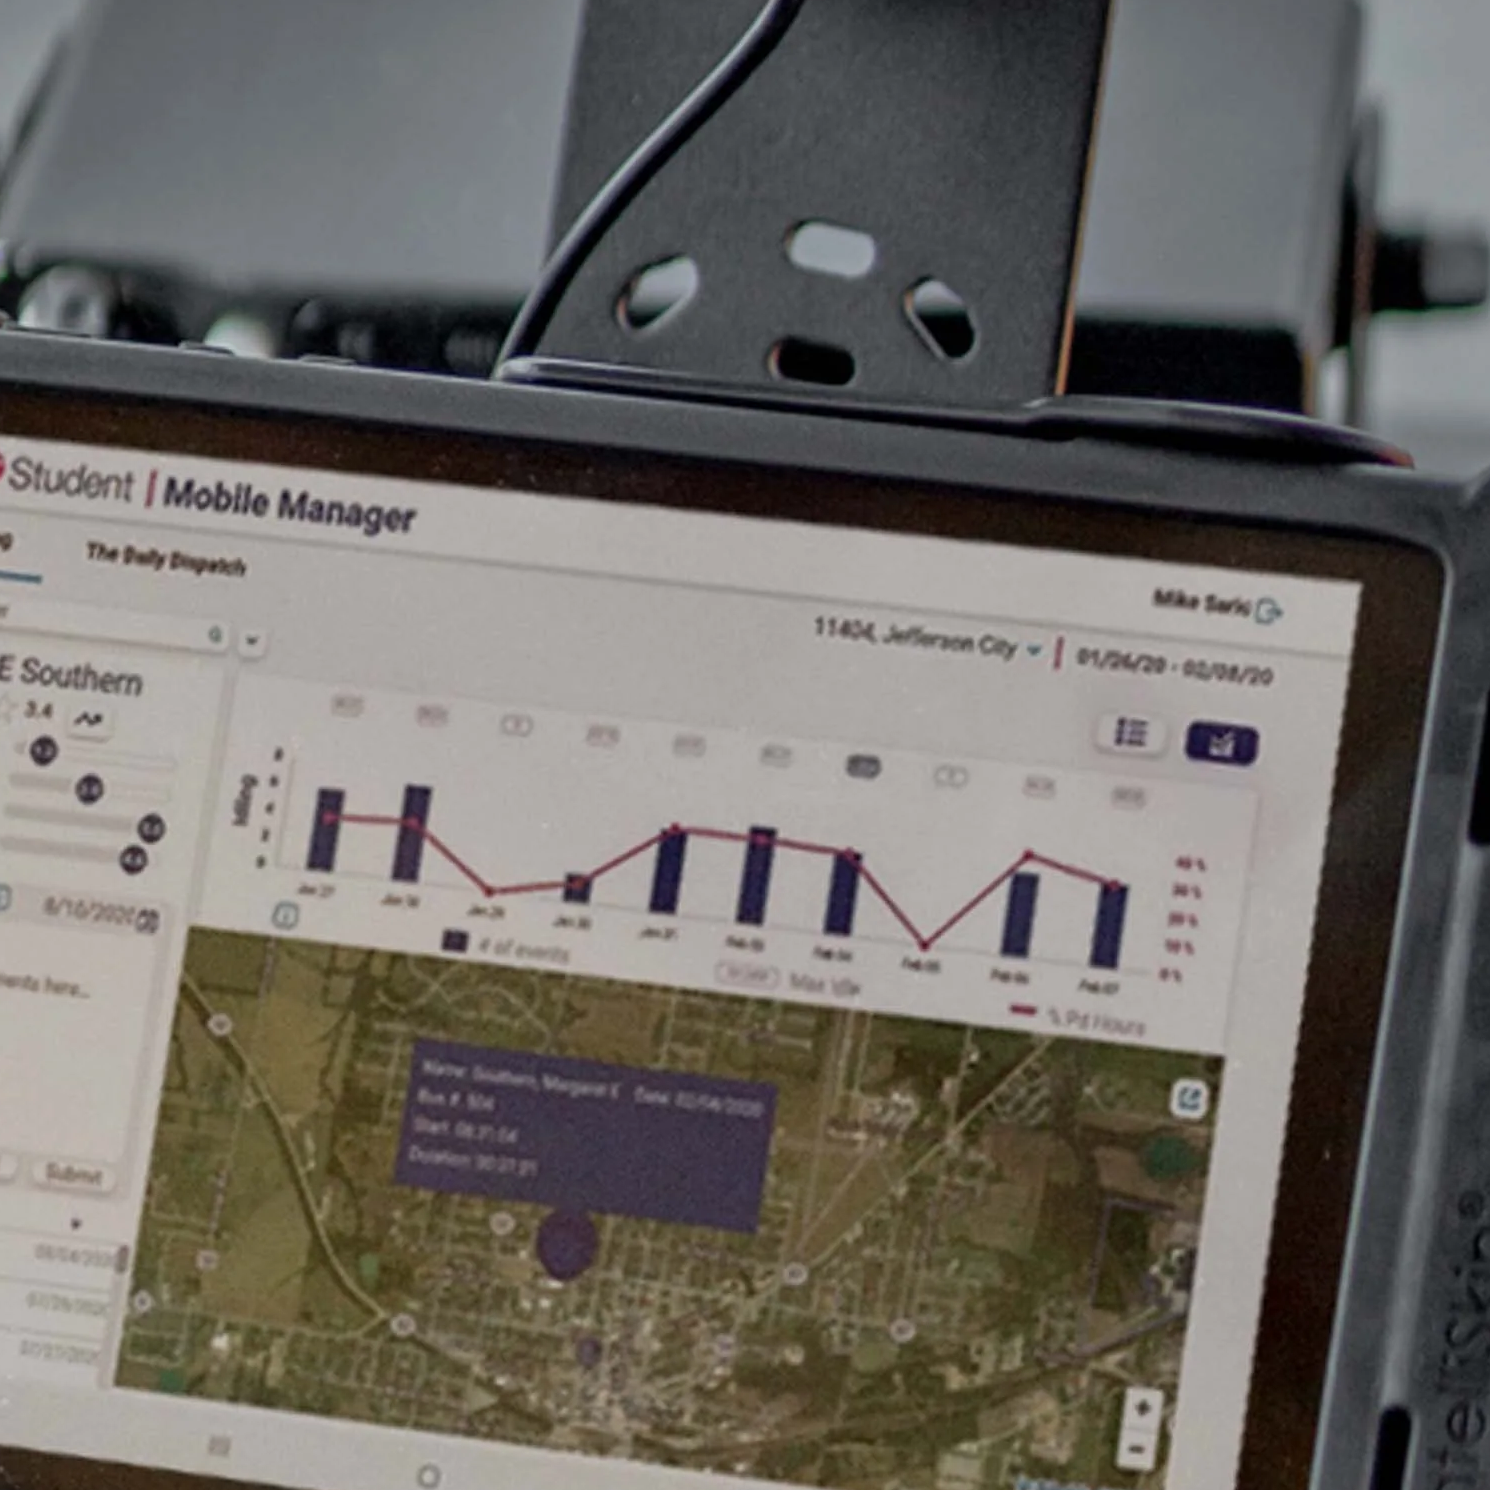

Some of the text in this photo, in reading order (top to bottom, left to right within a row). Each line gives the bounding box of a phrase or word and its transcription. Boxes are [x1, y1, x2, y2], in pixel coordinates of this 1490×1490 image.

[8, 456, 135, 503] Student
[163, 476, 417, 537] Mobile Manager
[86, 541, 119, 561] The
[123, 545, 166, 571] Daily
[882, 624, 976, 654] Jefferson
[980, 633, 1018, 662] City
[19, 658, 144, 697] Southern
[515, 943, 571, 963] events
[45, 1160, 104, 1186] Submit
